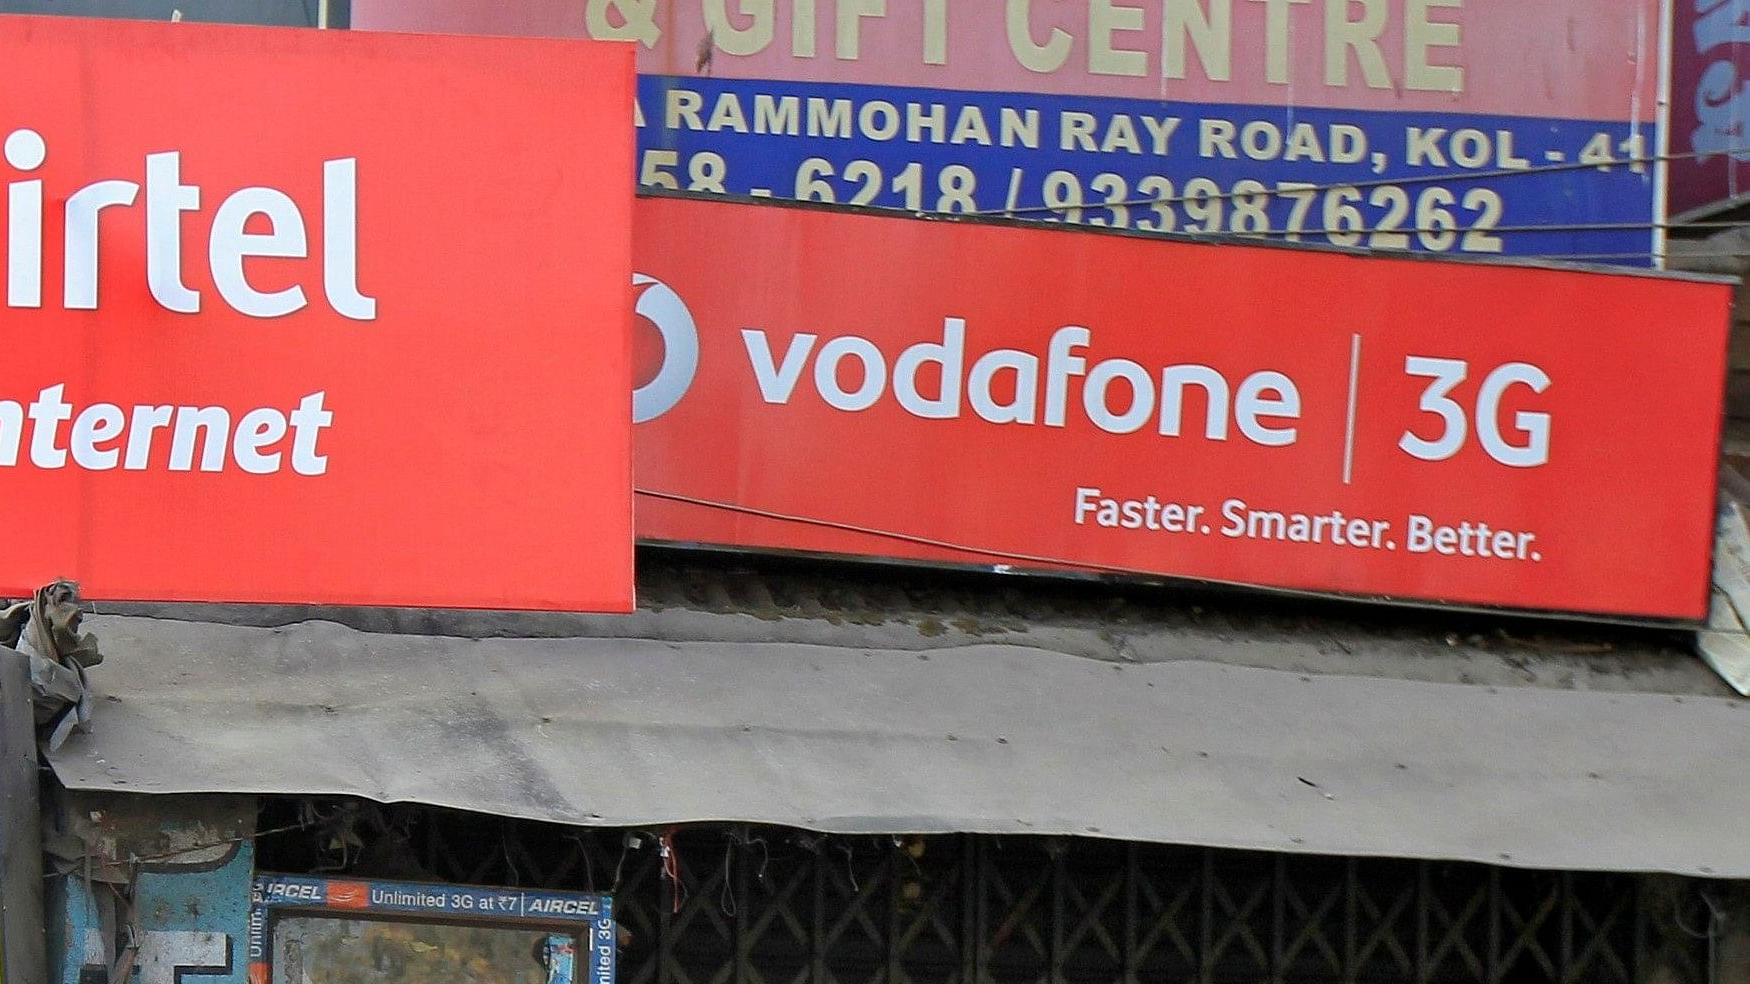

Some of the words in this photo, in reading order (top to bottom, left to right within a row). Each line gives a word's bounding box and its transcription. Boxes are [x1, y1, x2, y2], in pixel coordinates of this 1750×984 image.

[1005, 0, 1464, 92] CENTRE
[666, 89, 1040, 150] RAMMOHAN
[1061, 111, 1181, 156] RAY
[1199, 119, 1387, 174] ROAD,
[1406, 127, 1530, 170] KOL
[1578, 133, 1647, 174] 41
[795, 158, 978, 215] 6218
[1041, 171, 1504, 254] 9339876262
[740, 317, 1302, 447] vodafone
[1397, 355, 1552, 468] 3G
[1074, 486, 1211, 535] Faster.
[1220, 498, 1397, 550] Smarter.
[1406, 514, 1543, 562] Better.
[371, 889, 446, 908] Unlimited
[450, 893, 474, 910] 3G
[479, 897, 495, 911] at
[496, 897, 518, 912] ₹7
[528, 898, 600, 916] AIRCEL
